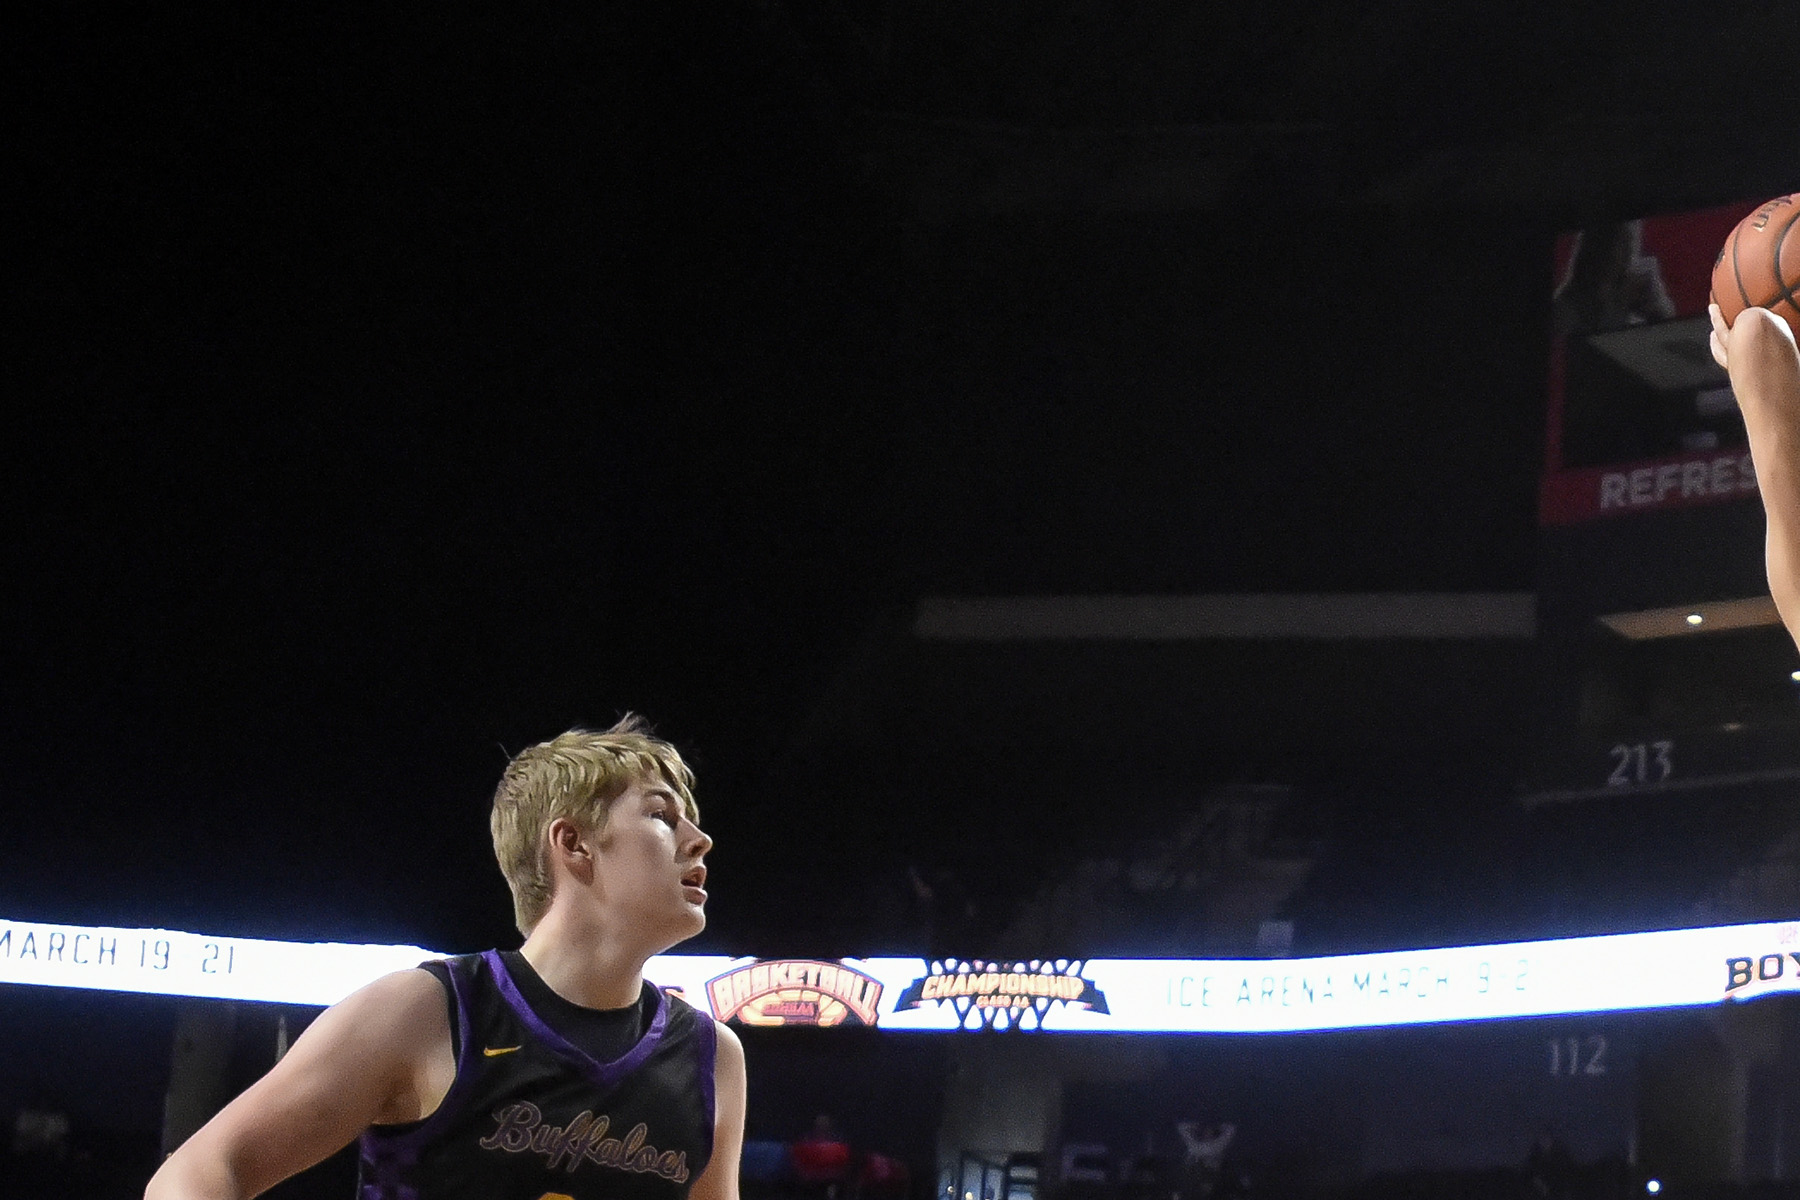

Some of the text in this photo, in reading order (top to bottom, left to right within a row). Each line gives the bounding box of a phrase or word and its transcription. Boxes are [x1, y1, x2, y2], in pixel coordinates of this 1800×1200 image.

[1608, 739, 1675, 786] 213
[140, 938, 171, 971] 19
[201, 942, 235, 975] 21
[713, 962, 877, 1022] BASKETBALL
[922, 974, 1084, 1001] CHAMPIONSHIP
[1166, 976, 1213, 1008] ICE
[1237, 976, 1335, 1007] ARENA
[1353, 965, 1449, 1000] MARCH
[1551, 1036, 1605, 1076] 112
[480, 1100, 690, 1184] Buffaloes
